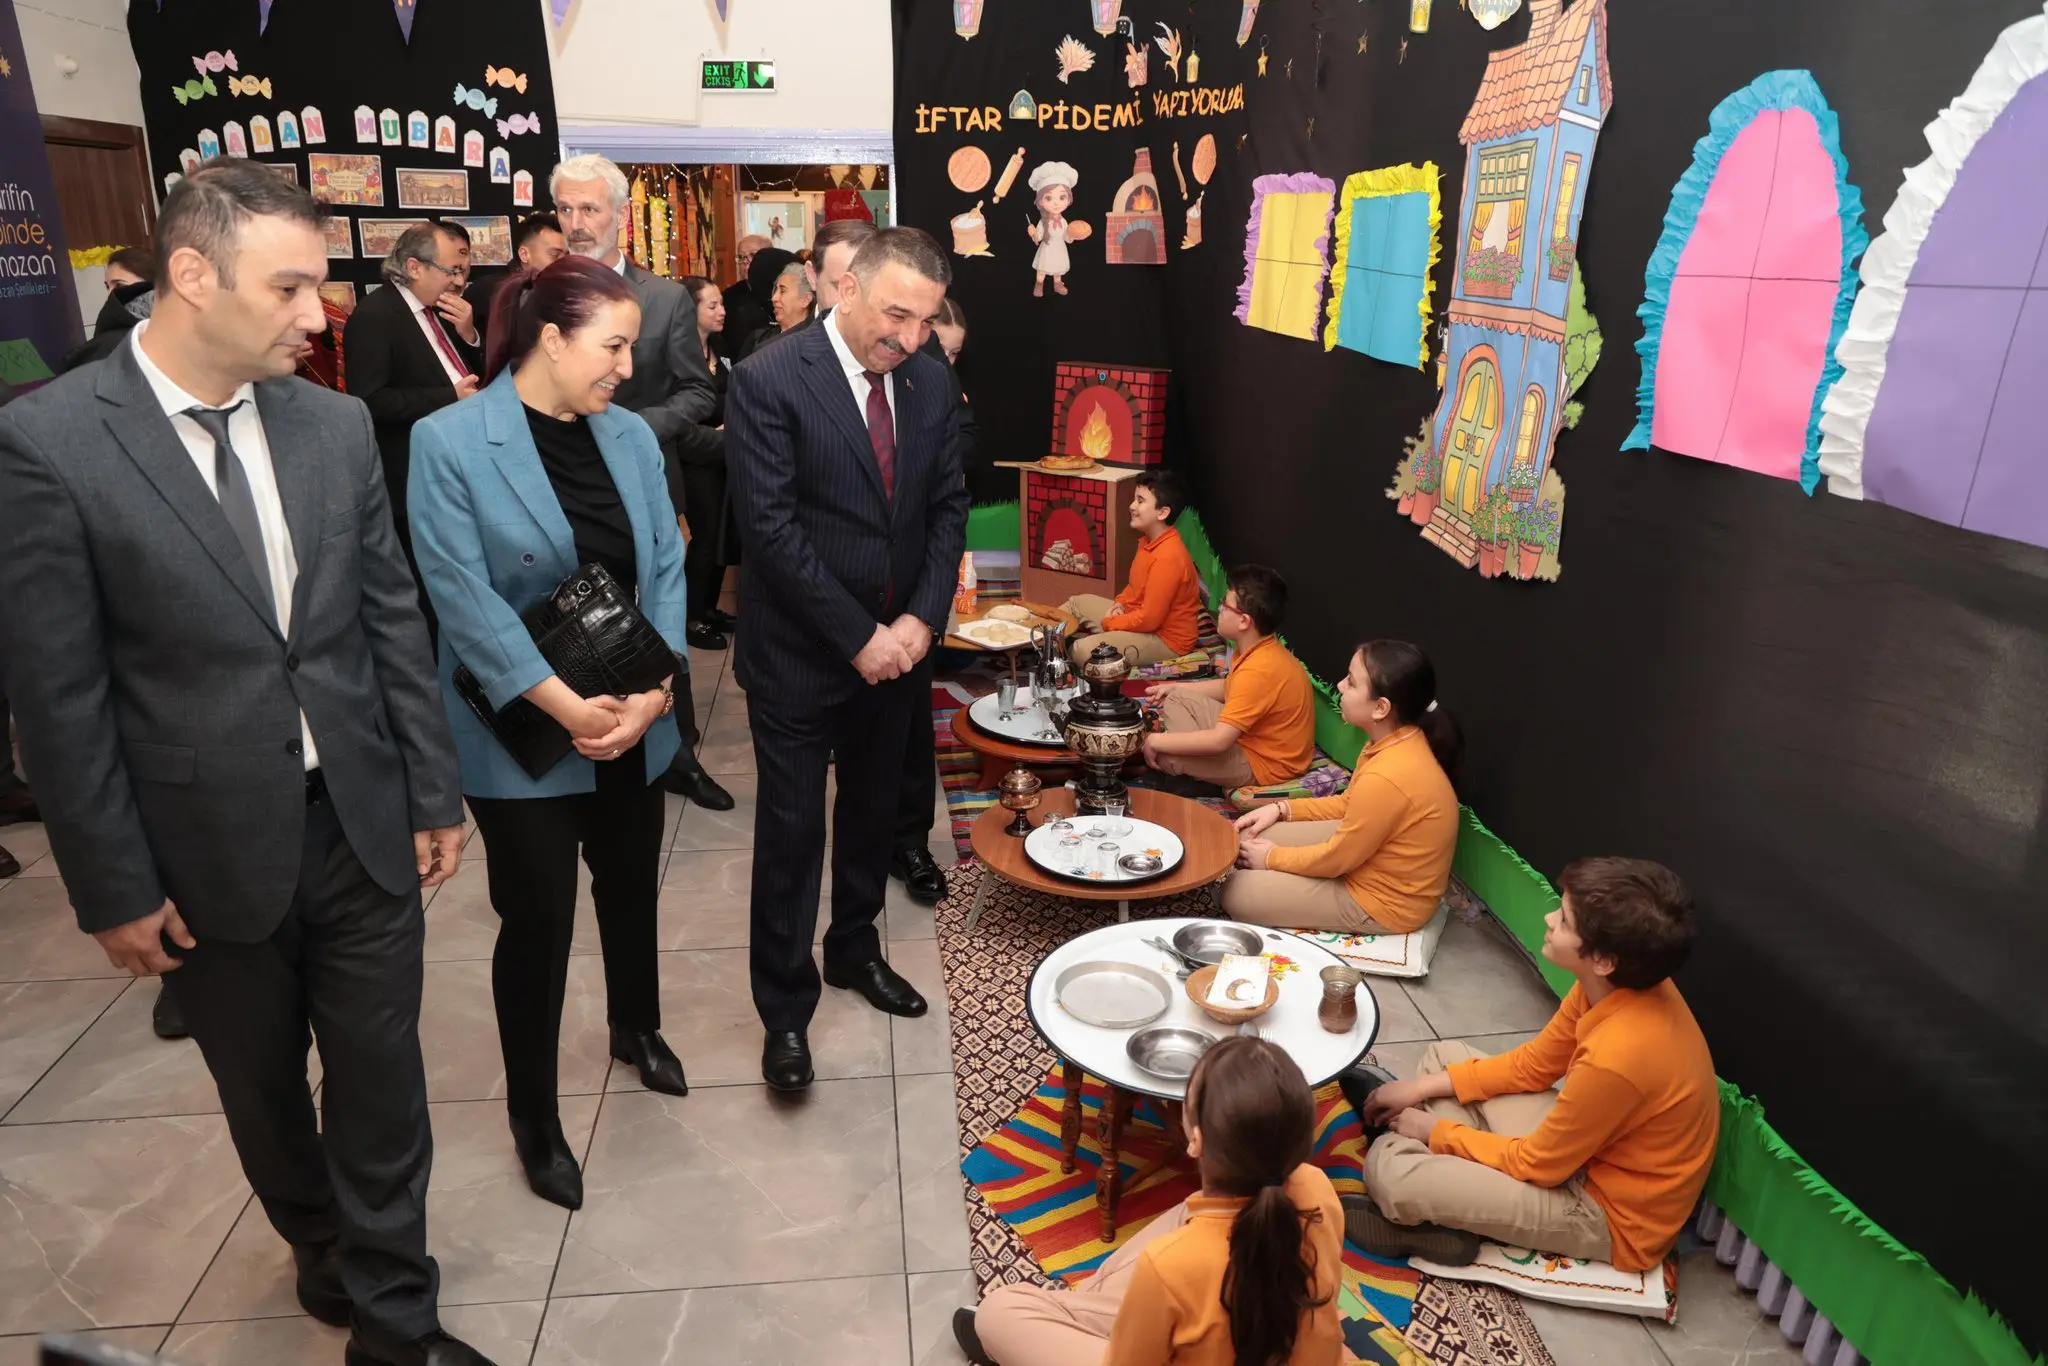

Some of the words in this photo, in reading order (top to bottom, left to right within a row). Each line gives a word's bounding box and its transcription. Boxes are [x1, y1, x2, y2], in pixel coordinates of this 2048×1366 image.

[705, 65, 730, 76] EXIT
[915, 103, 1002, 133] İFTAR
[1038, 90, 1143, 131] PİDEMİ
[1153, 82, 1245, 119] YAPIYORUM
[168, 117, 325, 189] MADAN
[357, 117, 533, 200] MUBARAK
